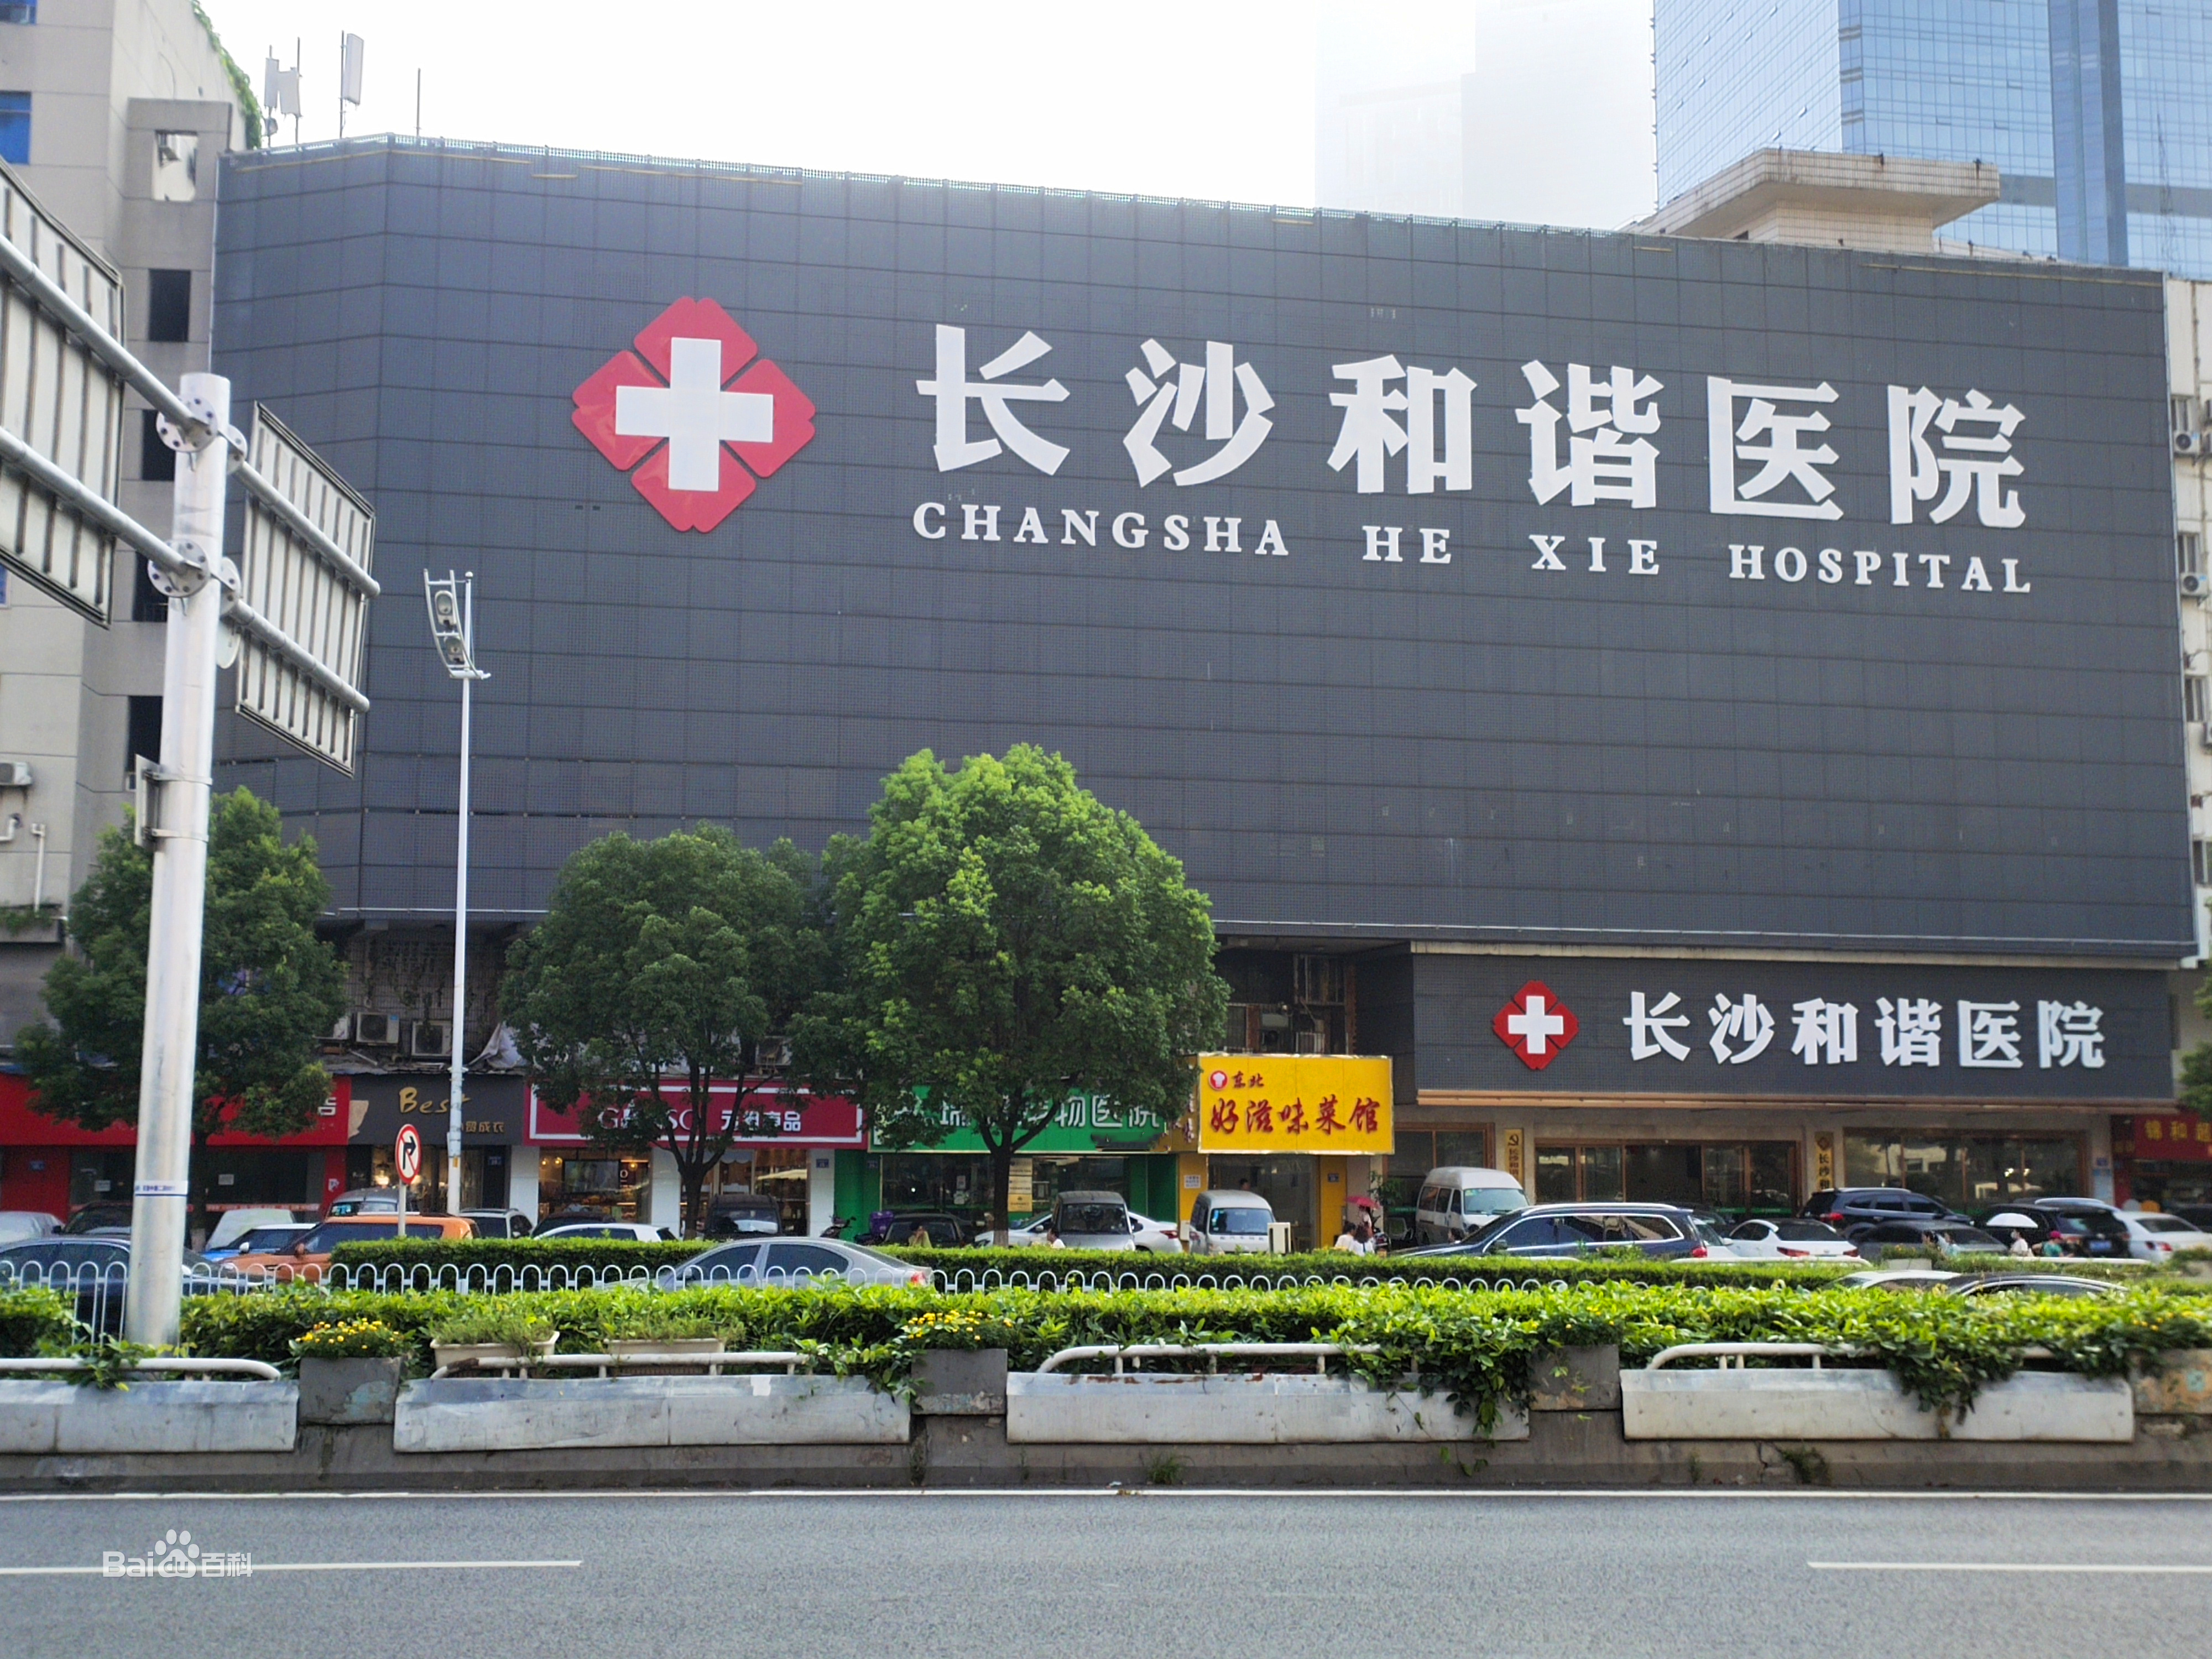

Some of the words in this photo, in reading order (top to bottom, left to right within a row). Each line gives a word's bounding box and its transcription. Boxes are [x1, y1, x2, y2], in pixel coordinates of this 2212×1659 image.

[916, 324, 2026, 528] 长沙和谐医院
[913, 502, 1289, 556] CHANGSHA
[1362, 525, 1452, 564] HE
[1528, 534, 1660, 575] XIE
[1728, 544, 2031, 593] HOSPITAL
[1623, 991, 2105, 1068] 长沙和谐医院
[1233, 1071, 1264, 1089] 东北
[461, 1121, 505, 1133] 贸成衣
[1211, 1094, 1380, 1135] 好滋味菜馆
